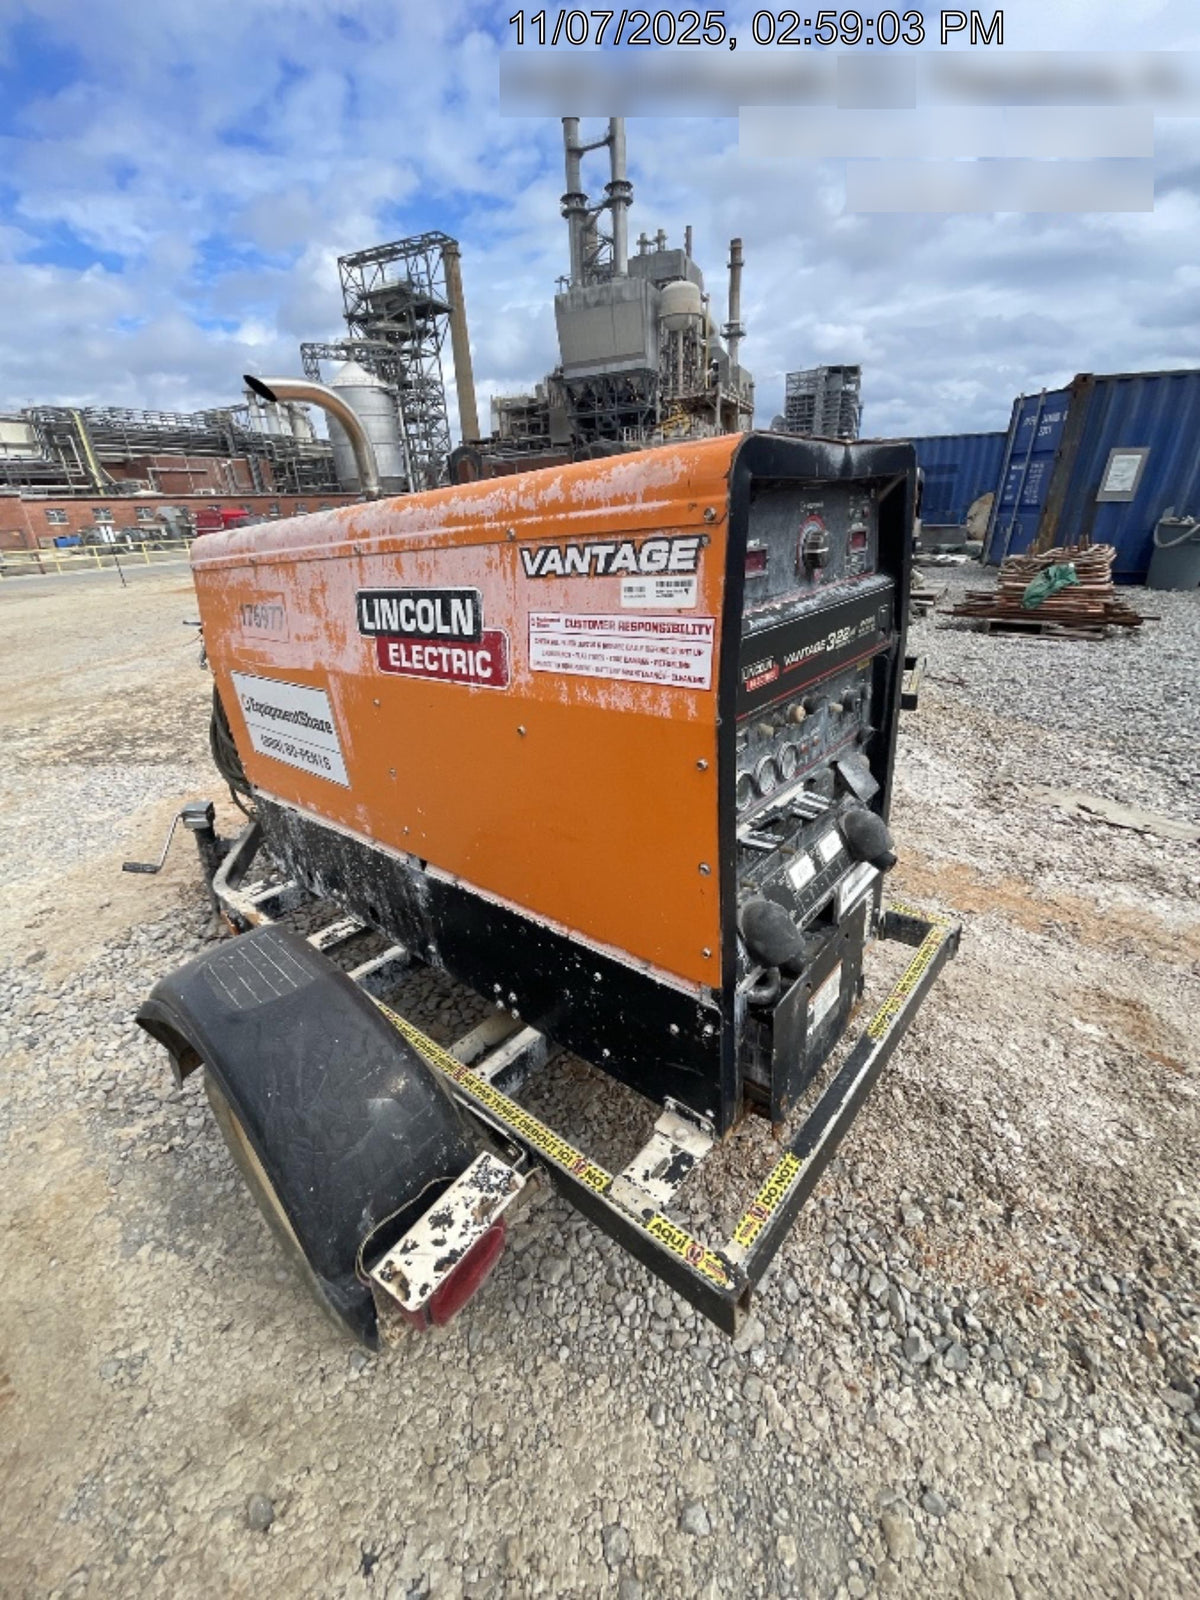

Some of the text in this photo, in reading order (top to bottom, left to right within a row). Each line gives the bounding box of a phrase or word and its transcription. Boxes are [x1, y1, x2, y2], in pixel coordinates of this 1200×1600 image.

[519, 535, 701, 578] VANTAGE
[361, 598, 475, 636] LINCOLN
[564, 617, 711, 636] CUSTOMER RESPONSIBILITY
[388, 643, 493, 679] ELECTRIC
[584, 1170, 604, 1187] NO
[762, 1163, 795, 1207] DO NOT
